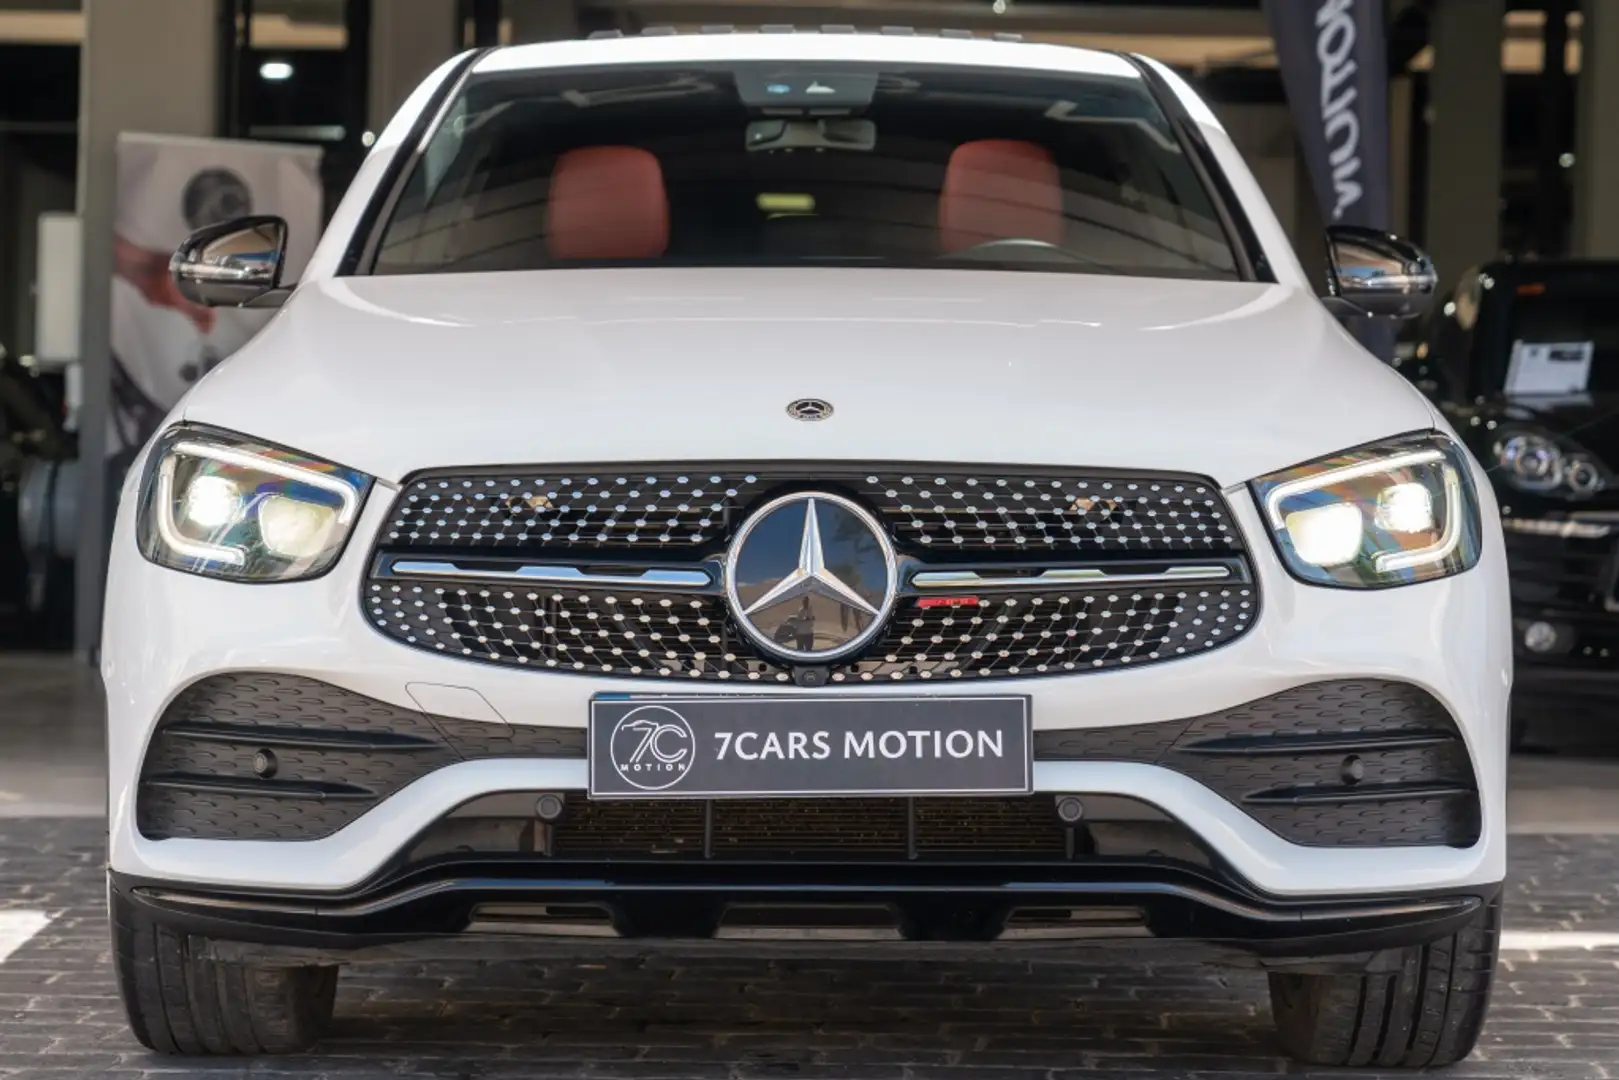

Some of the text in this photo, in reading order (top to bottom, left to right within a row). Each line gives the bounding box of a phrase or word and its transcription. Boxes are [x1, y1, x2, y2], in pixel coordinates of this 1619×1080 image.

[621, 719, 688, 763] 7C
[714, 729, 1003, 760] 7CARS MOTION
[620, 763, 687, 772] MOTION
